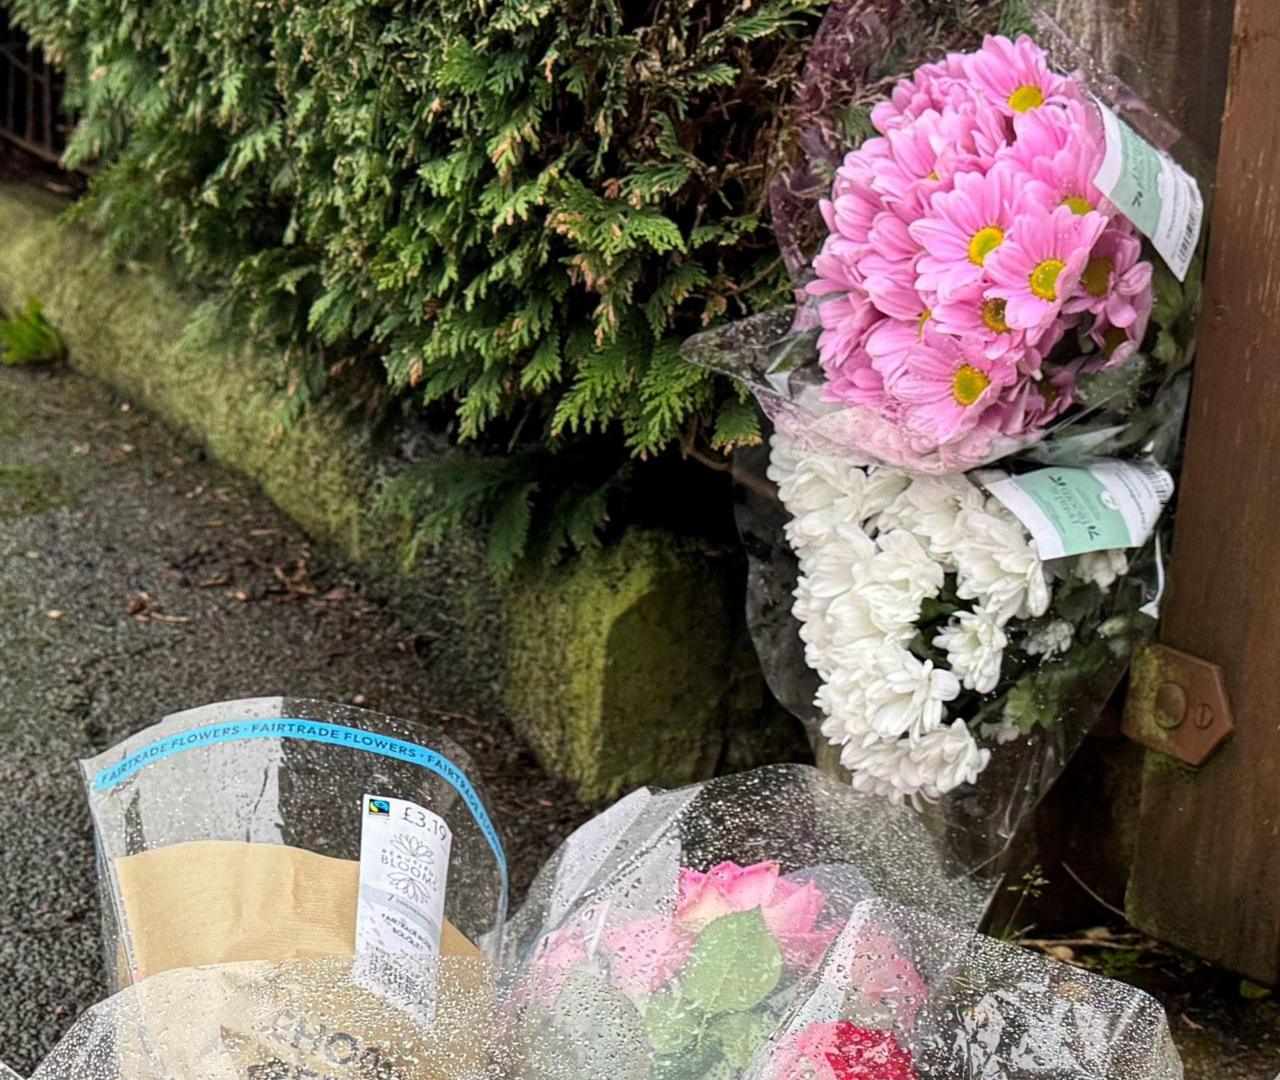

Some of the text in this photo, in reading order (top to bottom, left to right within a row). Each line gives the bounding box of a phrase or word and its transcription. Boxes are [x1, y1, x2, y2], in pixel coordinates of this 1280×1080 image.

[101, 743, 167, 783] FAIRTRADE
[171, 725, 240, 749] FLOWERS
[251, 723, 339, 740] FAIRTRADE
[343, 731, 417, 758] FLOWERS
[402, 807, 447, 841] £3.19
[381, 854, 438, 892] BLOOMS
